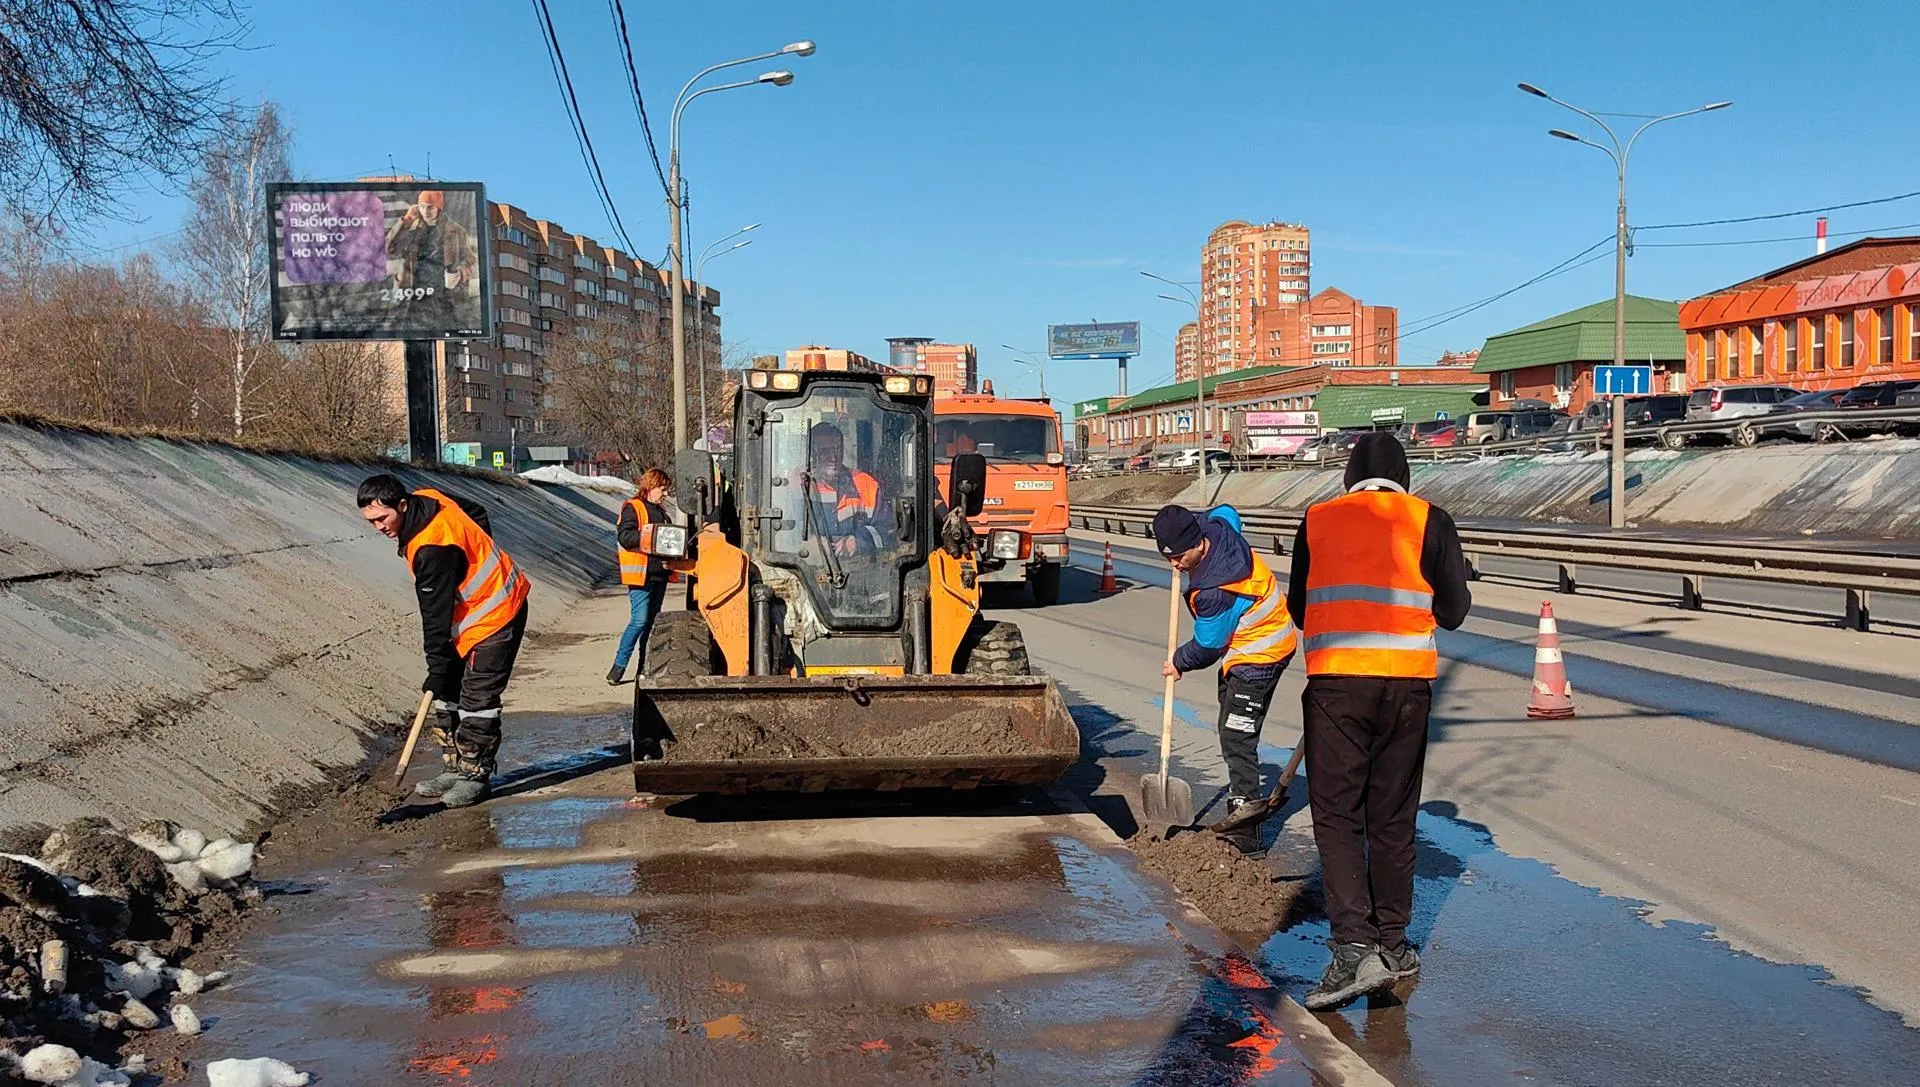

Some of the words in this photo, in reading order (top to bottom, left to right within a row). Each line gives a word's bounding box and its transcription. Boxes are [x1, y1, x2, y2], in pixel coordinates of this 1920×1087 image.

[289, 202, 330, 214] люди
[290, 214, 369, 230] выбирают
[291, 232, 345, 243] пальто
[292, 248, 311, 258] на
